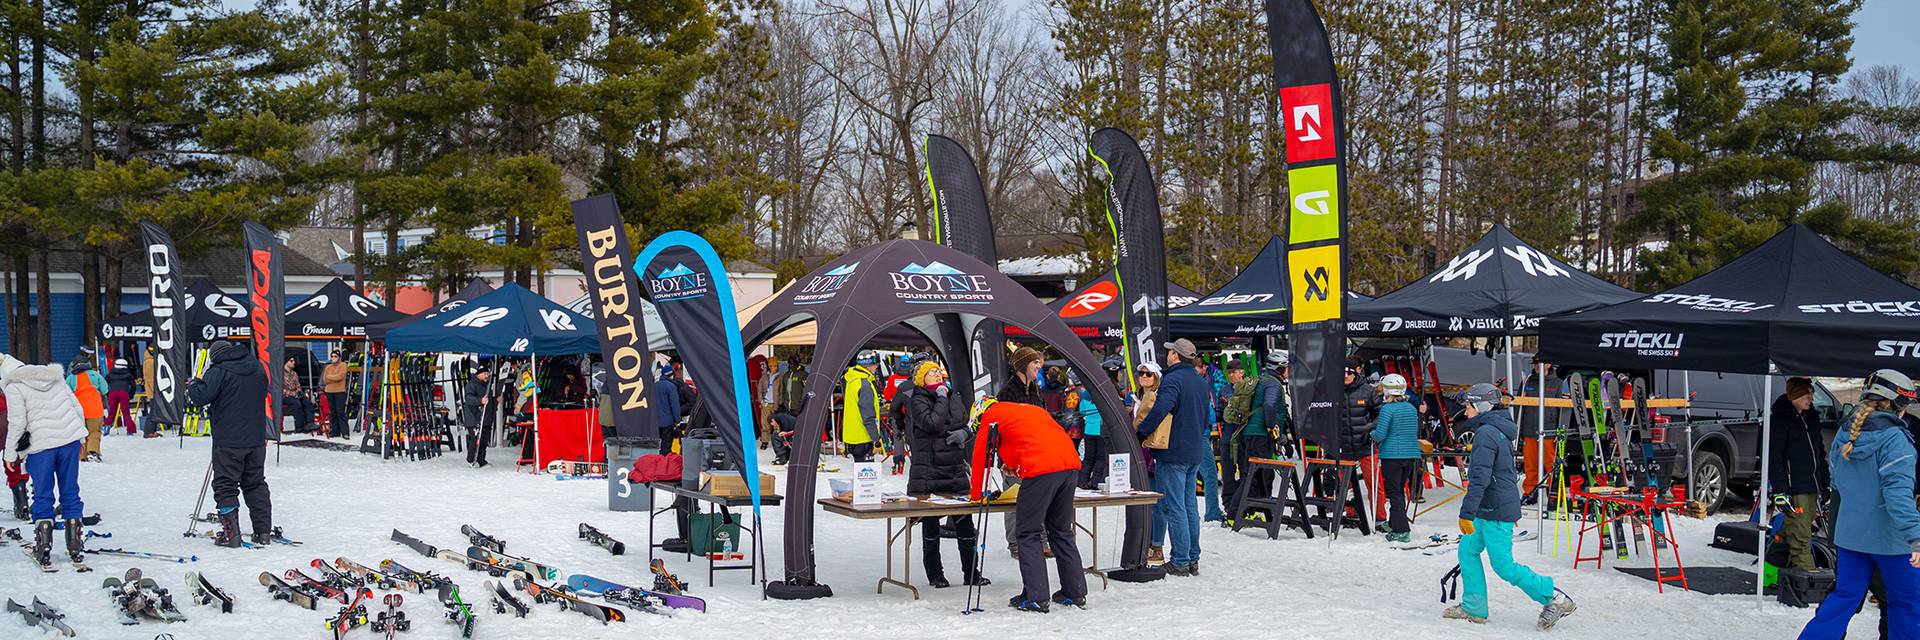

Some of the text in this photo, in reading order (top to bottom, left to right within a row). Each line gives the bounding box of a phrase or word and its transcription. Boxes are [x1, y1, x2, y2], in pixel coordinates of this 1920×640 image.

[650, 272, 707, 293] BOYNE
[888, 272, 991, 292] BOYNE
[149, 244, 173, 349] GIRO
[896, 292, 948, 300] COUNTRY
[1198, 293, 1274, 306] elan
[443, 306, 509, 328] K2
[539, 308, 577, 331] K2
[587, 225, 648, 411] BURTON
[1405, 320, 1437, 329] DALBELLO
[510, 337, 529, 352] K2
[1599, 330, 1684, 349] STÖCKLI
[617, 467, 631, 498] 3
